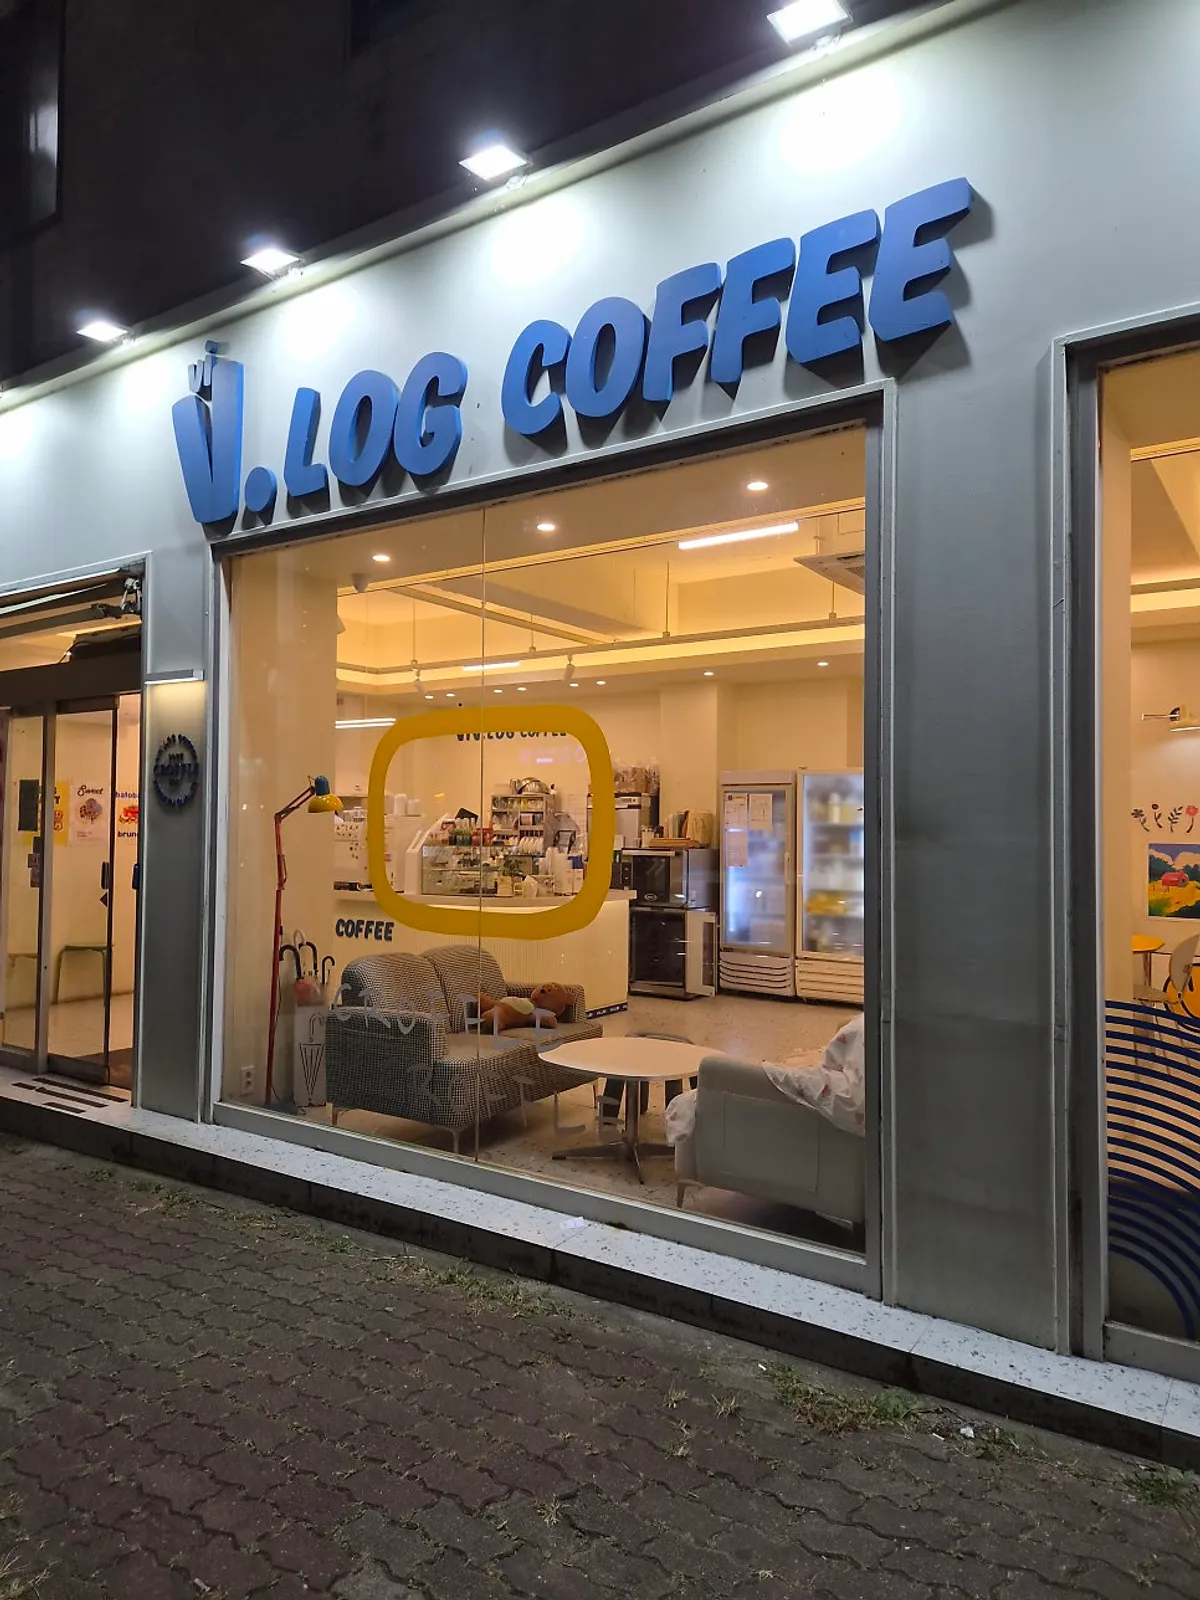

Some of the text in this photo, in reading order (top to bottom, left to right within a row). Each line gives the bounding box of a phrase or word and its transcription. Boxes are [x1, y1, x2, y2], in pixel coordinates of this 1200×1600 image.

[501, 177, 972, 436] COFFEE
[76, 784, 104, 797] Sweet
[336, 918, 394, 941] COFFEE
